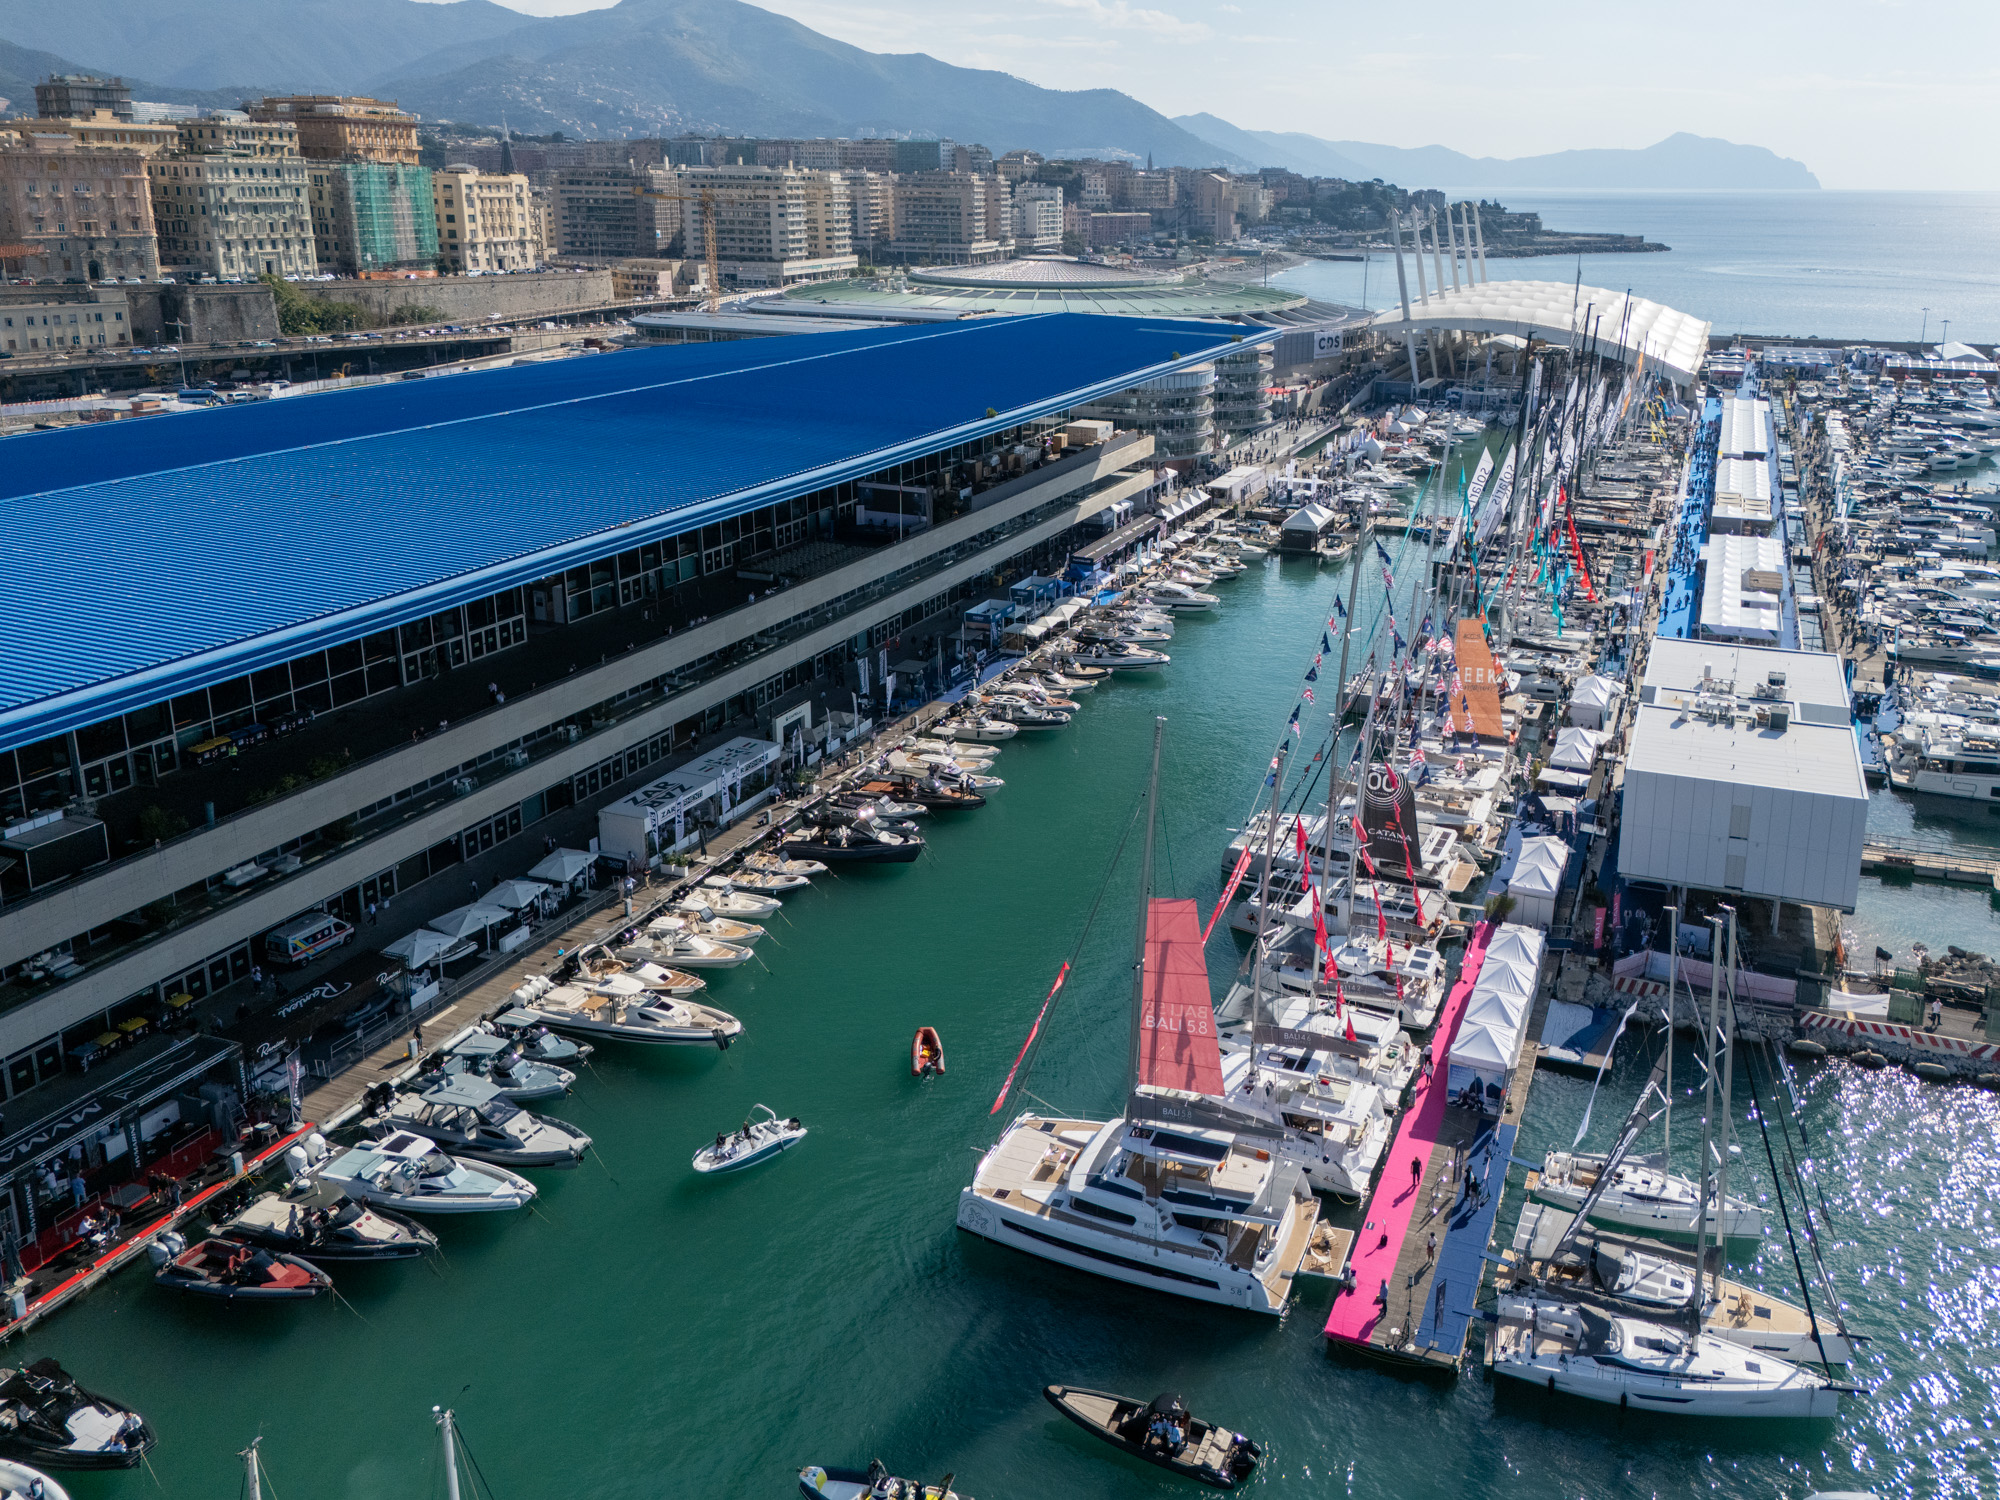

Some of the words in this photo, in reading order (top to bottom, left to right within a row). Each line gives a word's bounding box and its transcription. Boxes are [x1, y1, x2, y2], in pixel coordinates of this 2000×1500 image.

[1457, 667, 1496, 684] EEK
[624, 781, 676, 806] ZAR
[643, 783, 694, 808] ZAR
[1368, 828, 1413, 842] CATANA
[277, 982, 353, 1018] Ranieri
[1145, 1015, 1182, 1032] BALI
[1186, 1021, 1208, 1035] 5.8
[1162, 1108, 1180, 1117] BALI
[128, 1121, 142, 1169] MVMARINE
[24, 1182, 37, 1233] MVMARINE
